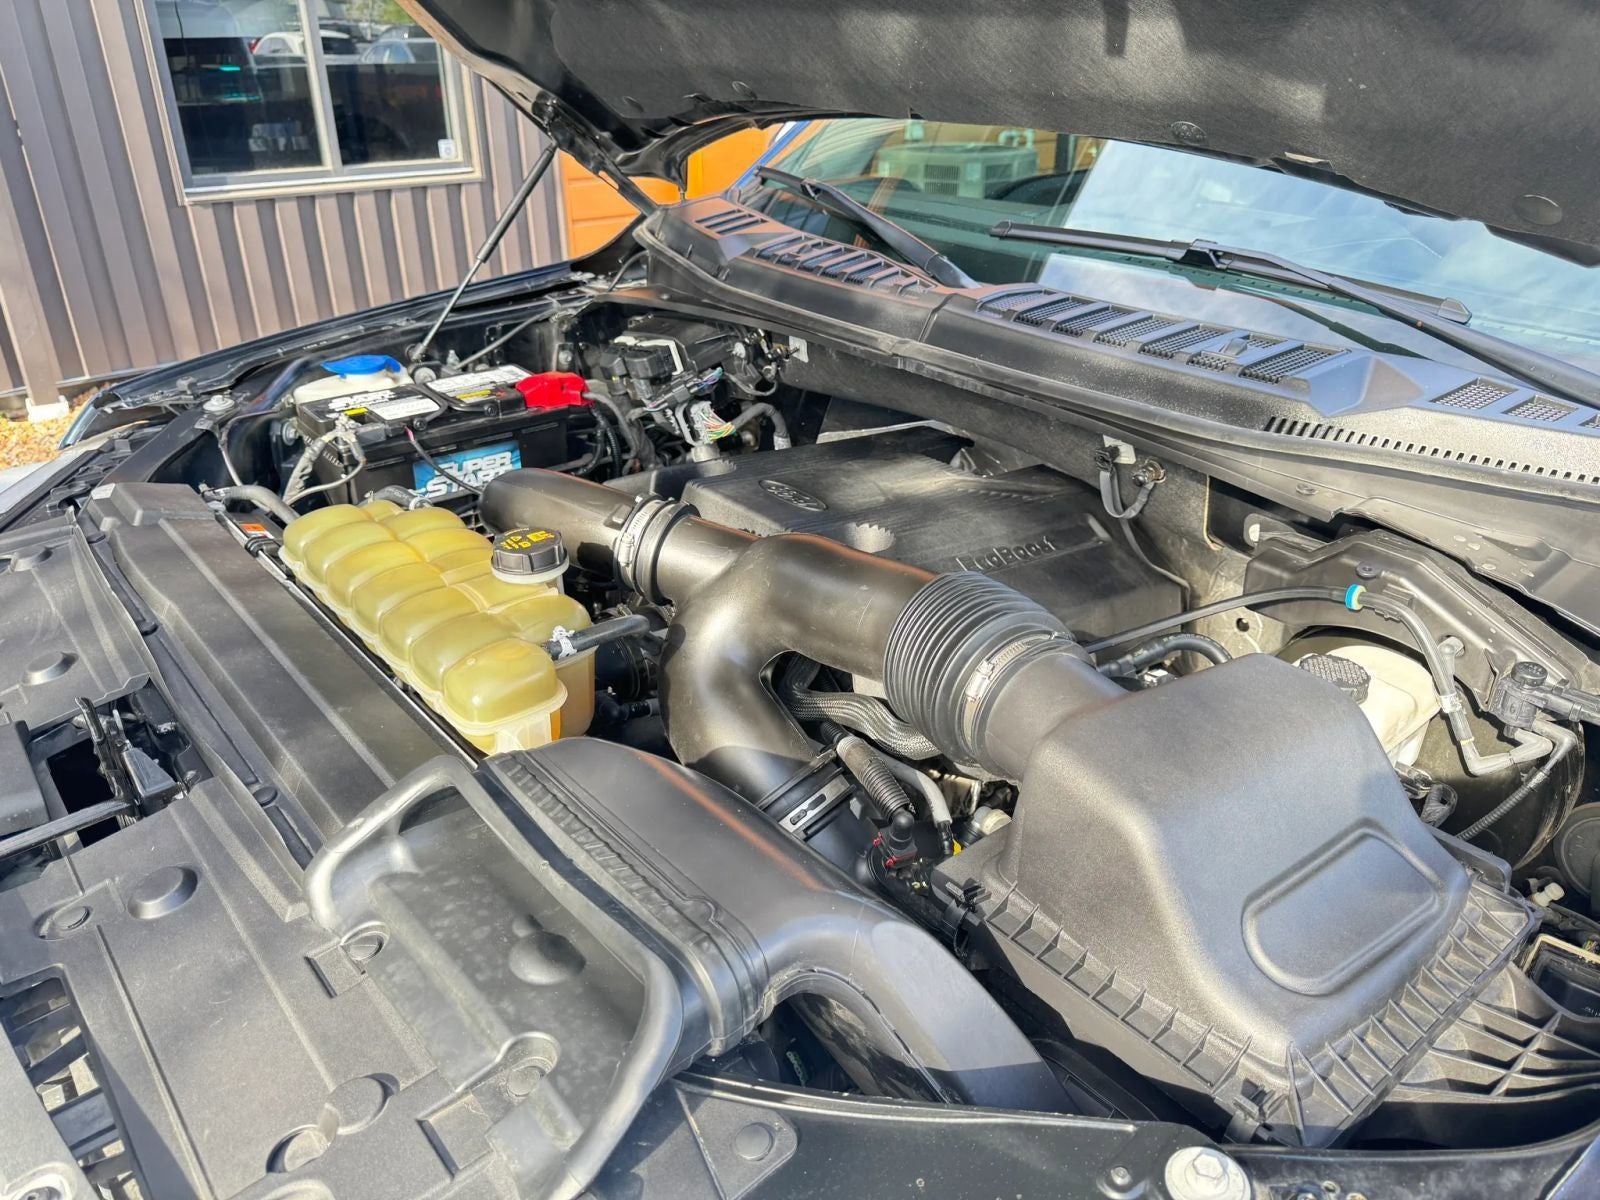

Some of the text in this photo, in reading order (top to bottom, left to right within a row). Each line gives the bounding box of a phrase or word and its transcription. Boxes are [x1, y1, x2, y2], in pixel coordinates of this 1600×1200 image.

[434, 450, 512, 477] SUPER
[765, 484, 819, 511] Ford
[955, 535, 1056, 571] EcoBoost
